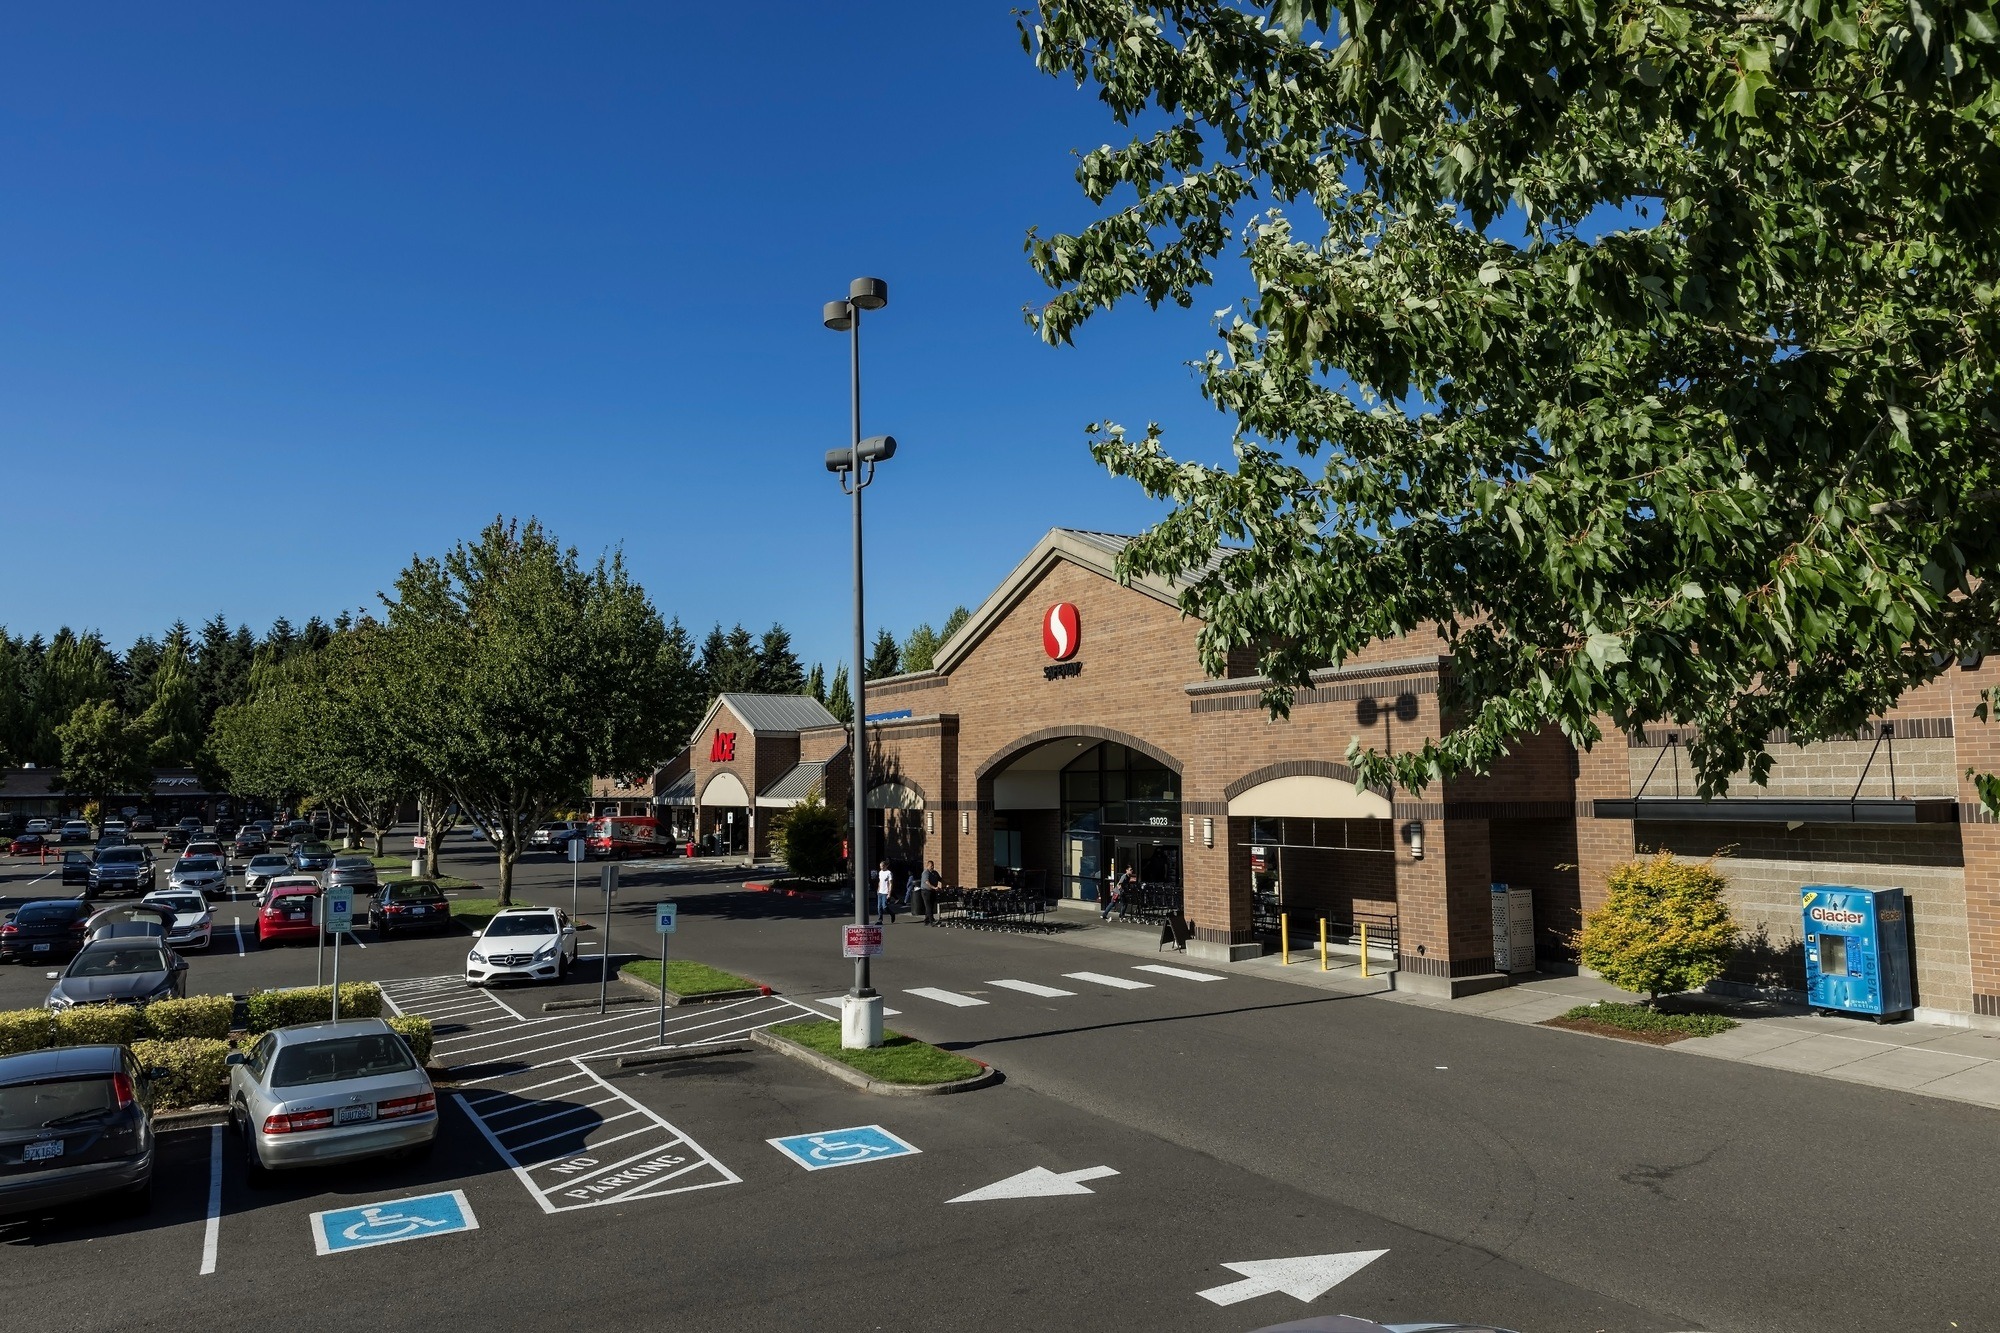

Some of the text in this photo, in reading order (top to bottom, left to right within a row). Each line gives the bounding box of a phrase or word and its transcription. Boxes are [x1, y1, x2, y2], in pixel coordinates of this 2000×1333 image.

[710, 729, 736, 762] ACE
[1149, 817, 1168, 826] 13023
[1811, 908, 1864, 924] Glacier
[1880, 909, 1902, 921] Glacier
[1865, 955, 1877, 997] water
[549, 1157, 600, 1174] NO
[563, 1154, 686, 1199] PARKING
